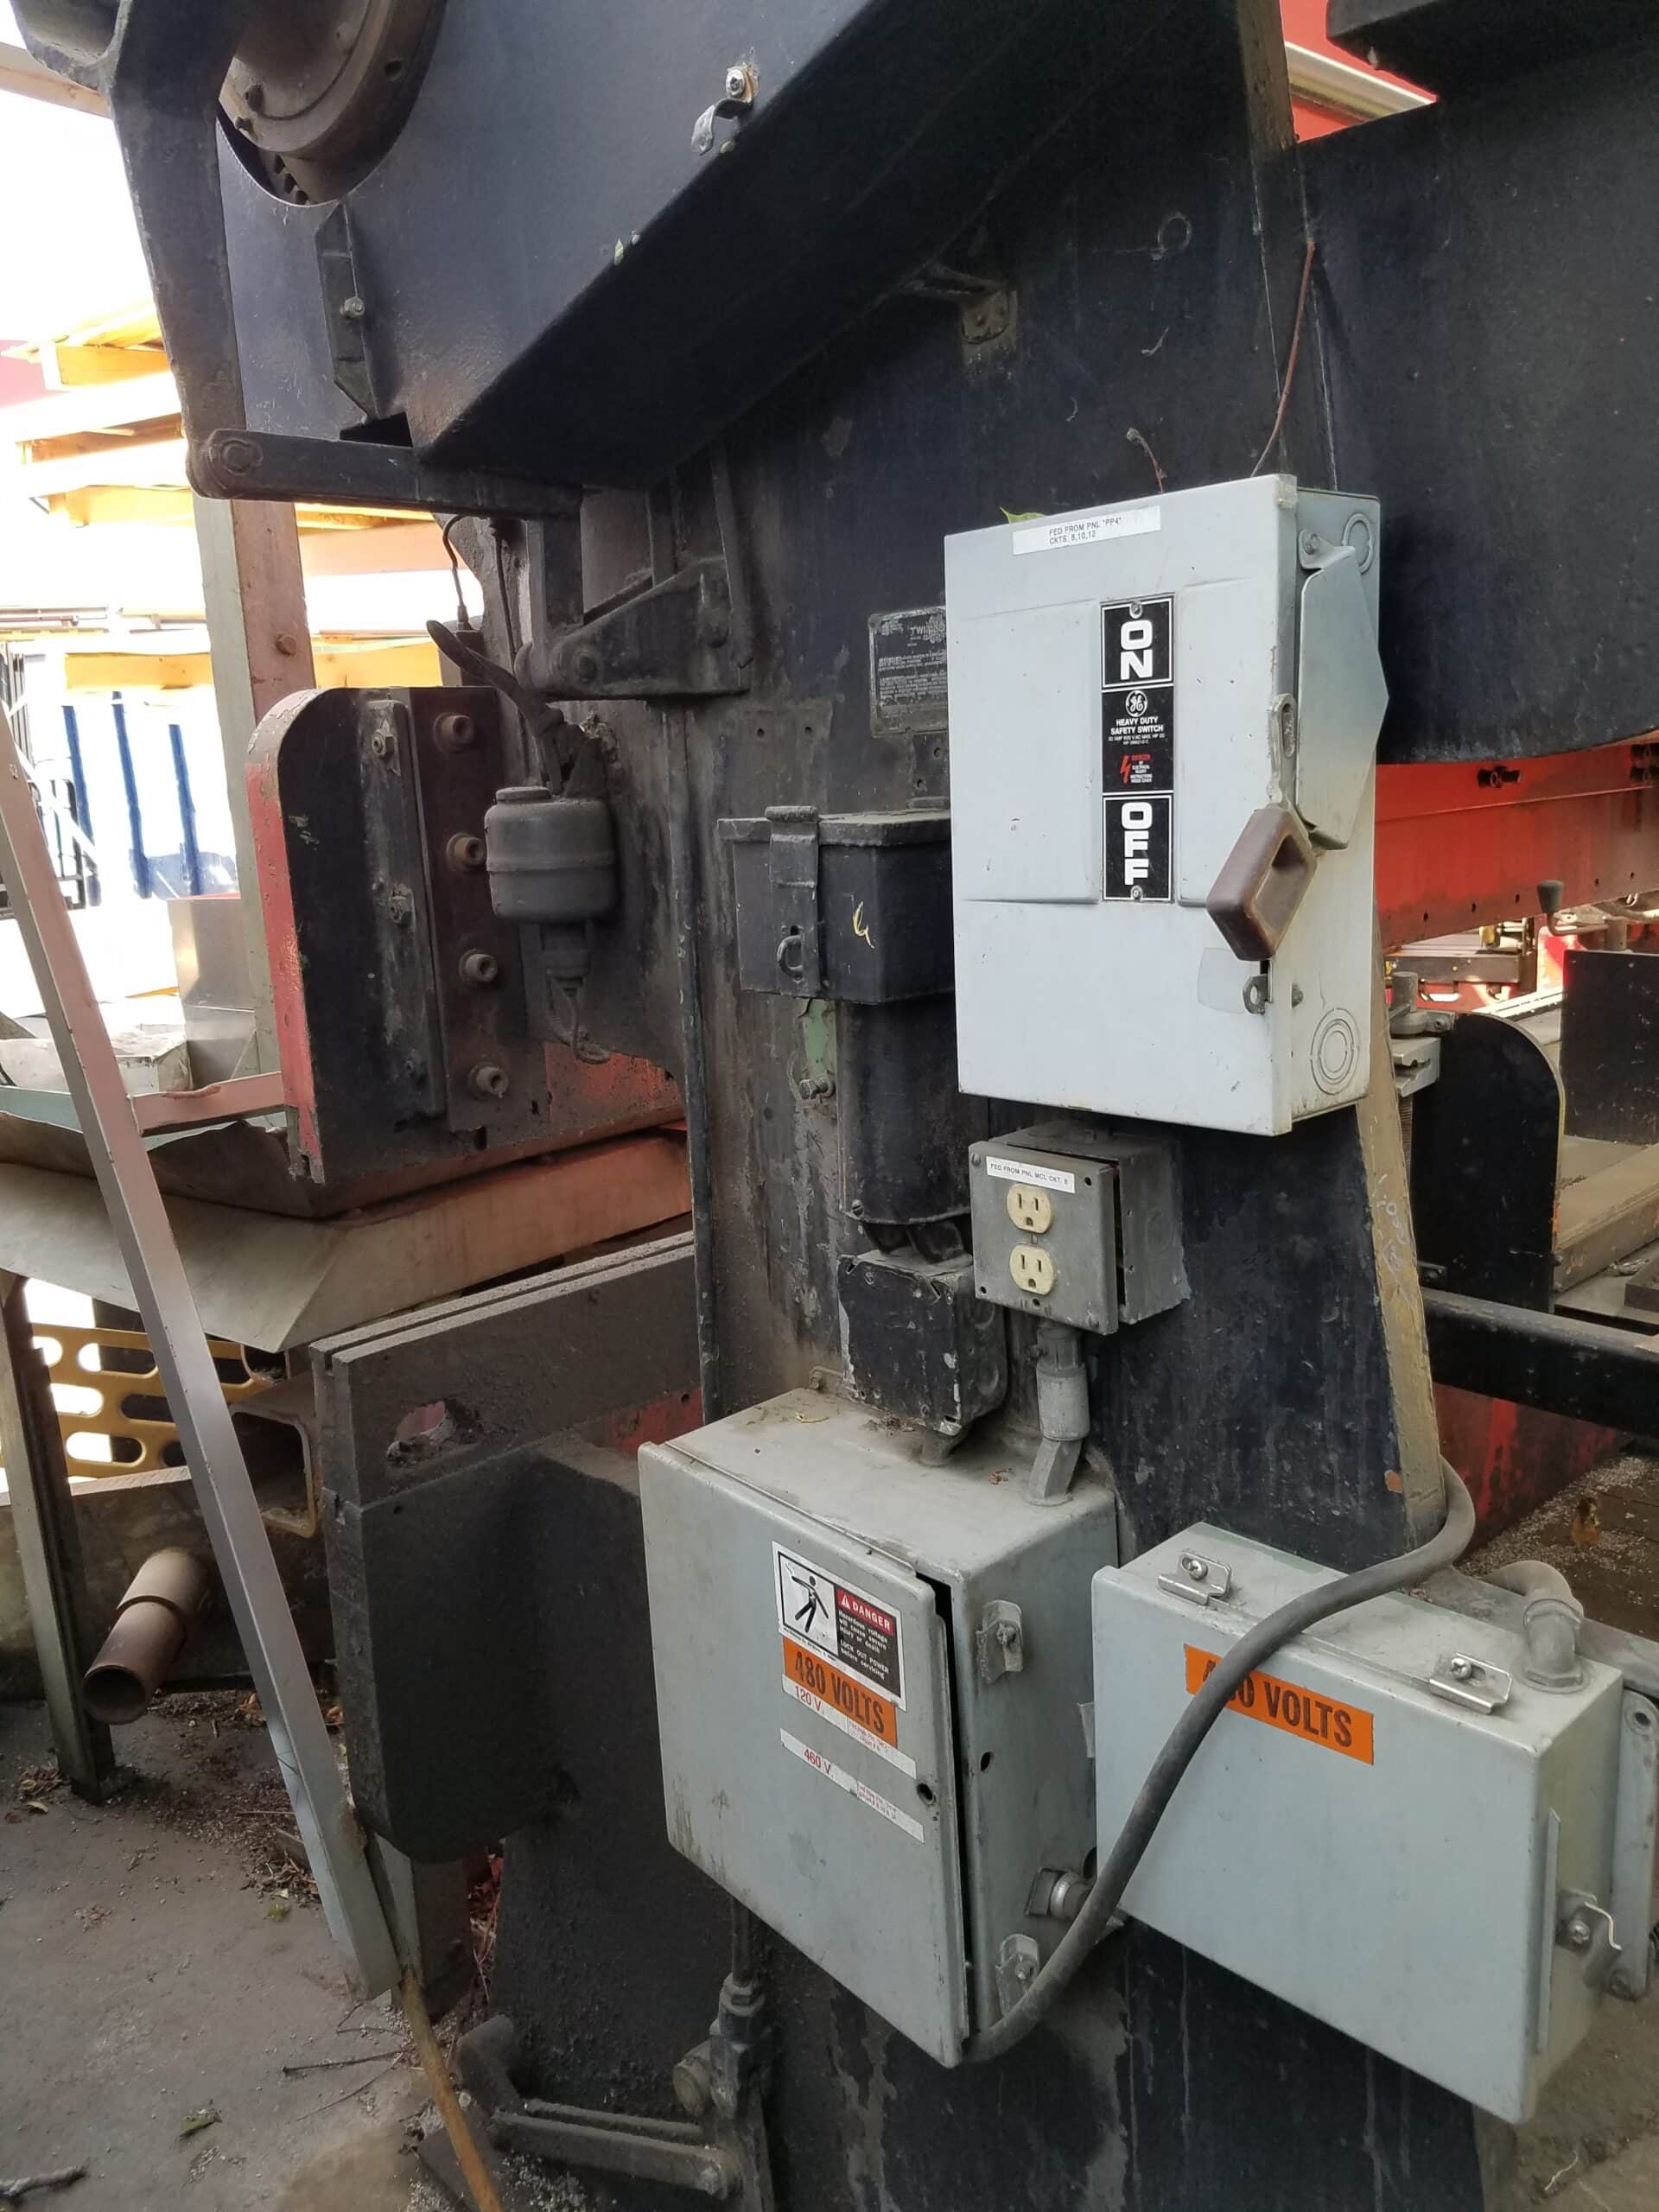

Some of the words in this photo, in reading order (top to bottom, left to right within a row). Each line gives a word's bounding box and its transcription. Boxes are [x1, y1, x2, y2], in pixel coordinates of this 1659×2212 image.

[1049, 527, 1063, 537] FED
[1065, 523, 1084, 533] FROM
[1086, 521, 1100, 530] PNL
[1121, 620, 1153, 680] ON
[1110, 726, 1136, 735] SAFETY
[1137, 724, 1164, 734] SWITCH
[1116, 718, 1139, 727] HEAVY
[1140, 715, 1159, 725] DUTY
[1122, 802, 1153, 886] OFF
[1003, 1166, 1020, 1175] FROM
[1021, 1169, 1033, 1178] PNL
[838, 1610, 865, 1630] Hazardous
[868, 1627, 888, 1644] voltage
[852, 1600, 890, 1631] DANGER
[850, 1624, 866, 1638] cause
[868, 1635, 887, 1651] severe
[840, 1638, 854, 1653] LOCK
[856, 1649, 867, 1660] OUT
[869, 1656, 889, 1675] POWER
[794, 1686, 812, 1707] 120
[795, 1651, 827, 1694] 480
[831, 1672, 885, 1734] VOLTS
[1264, 1681, 1352, 1748] VOLTS
[804, 1748, 821, 1769] 460
